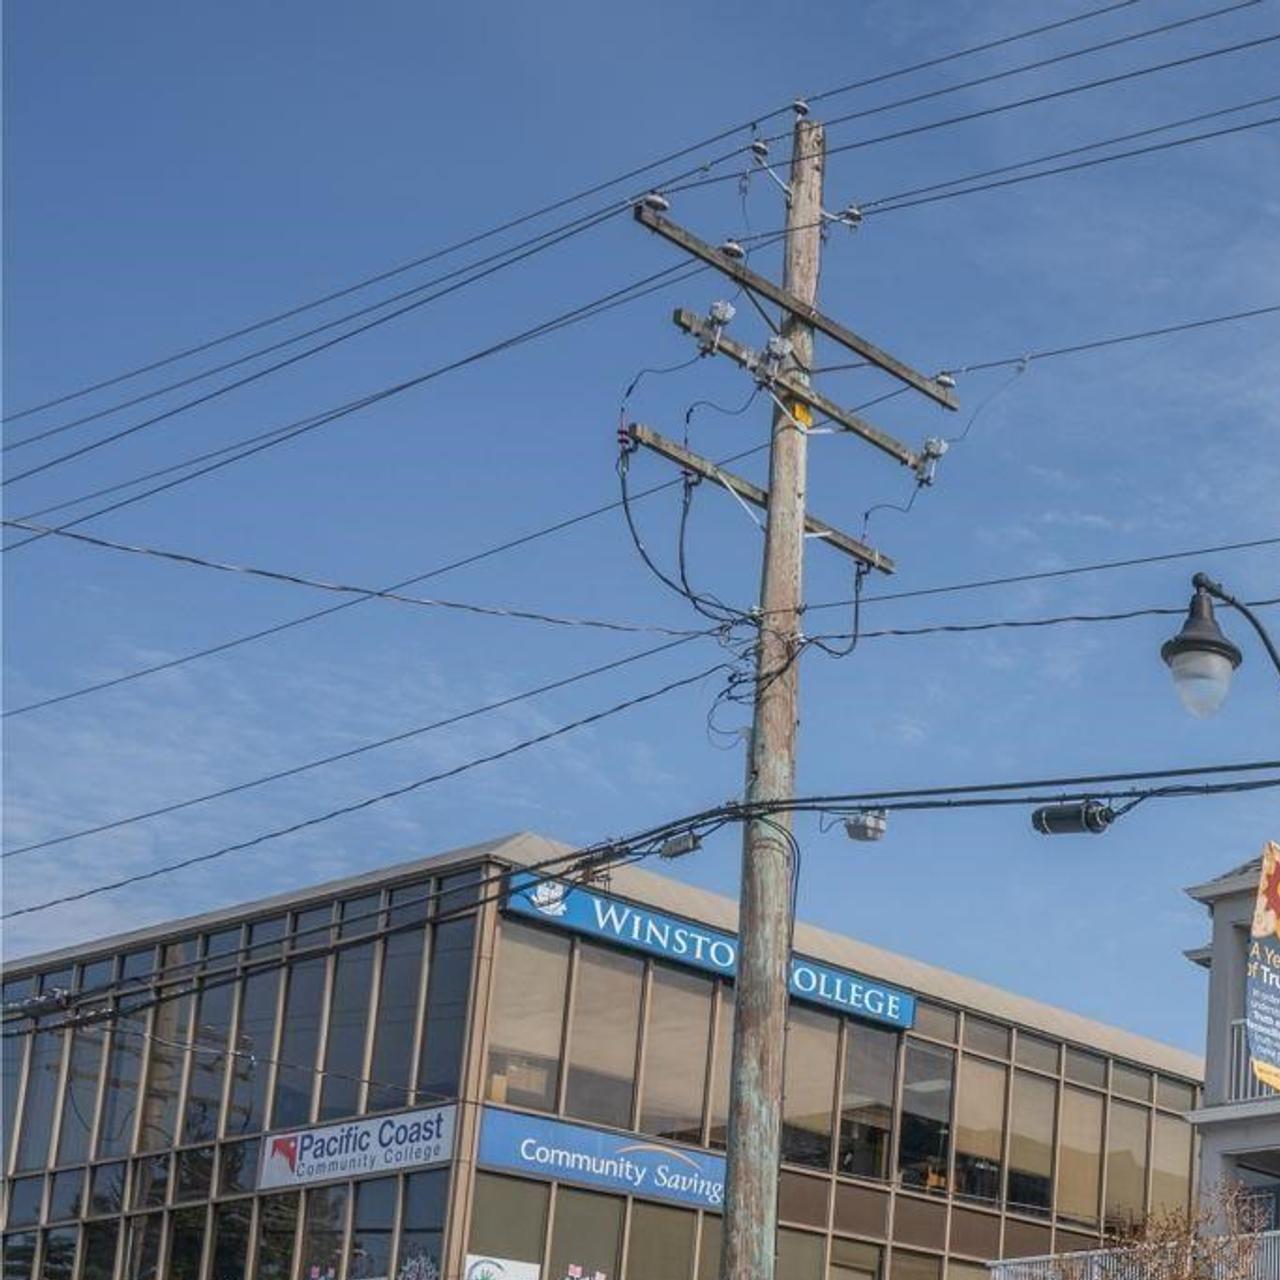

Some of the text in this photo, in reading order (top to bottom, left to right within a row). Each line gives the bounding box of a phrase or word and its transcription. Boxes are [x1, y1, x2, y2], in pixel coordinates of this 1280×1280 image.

[591, 897, 902, 1020] WINSTO OLLEGE
[1249, 942, 1261, 960] A
[296, 1144, 442, 1178] Community College
[299, 1112, 444, 1162] Pacific Coast
[520, 1138, 724, 1204] Community Saving
